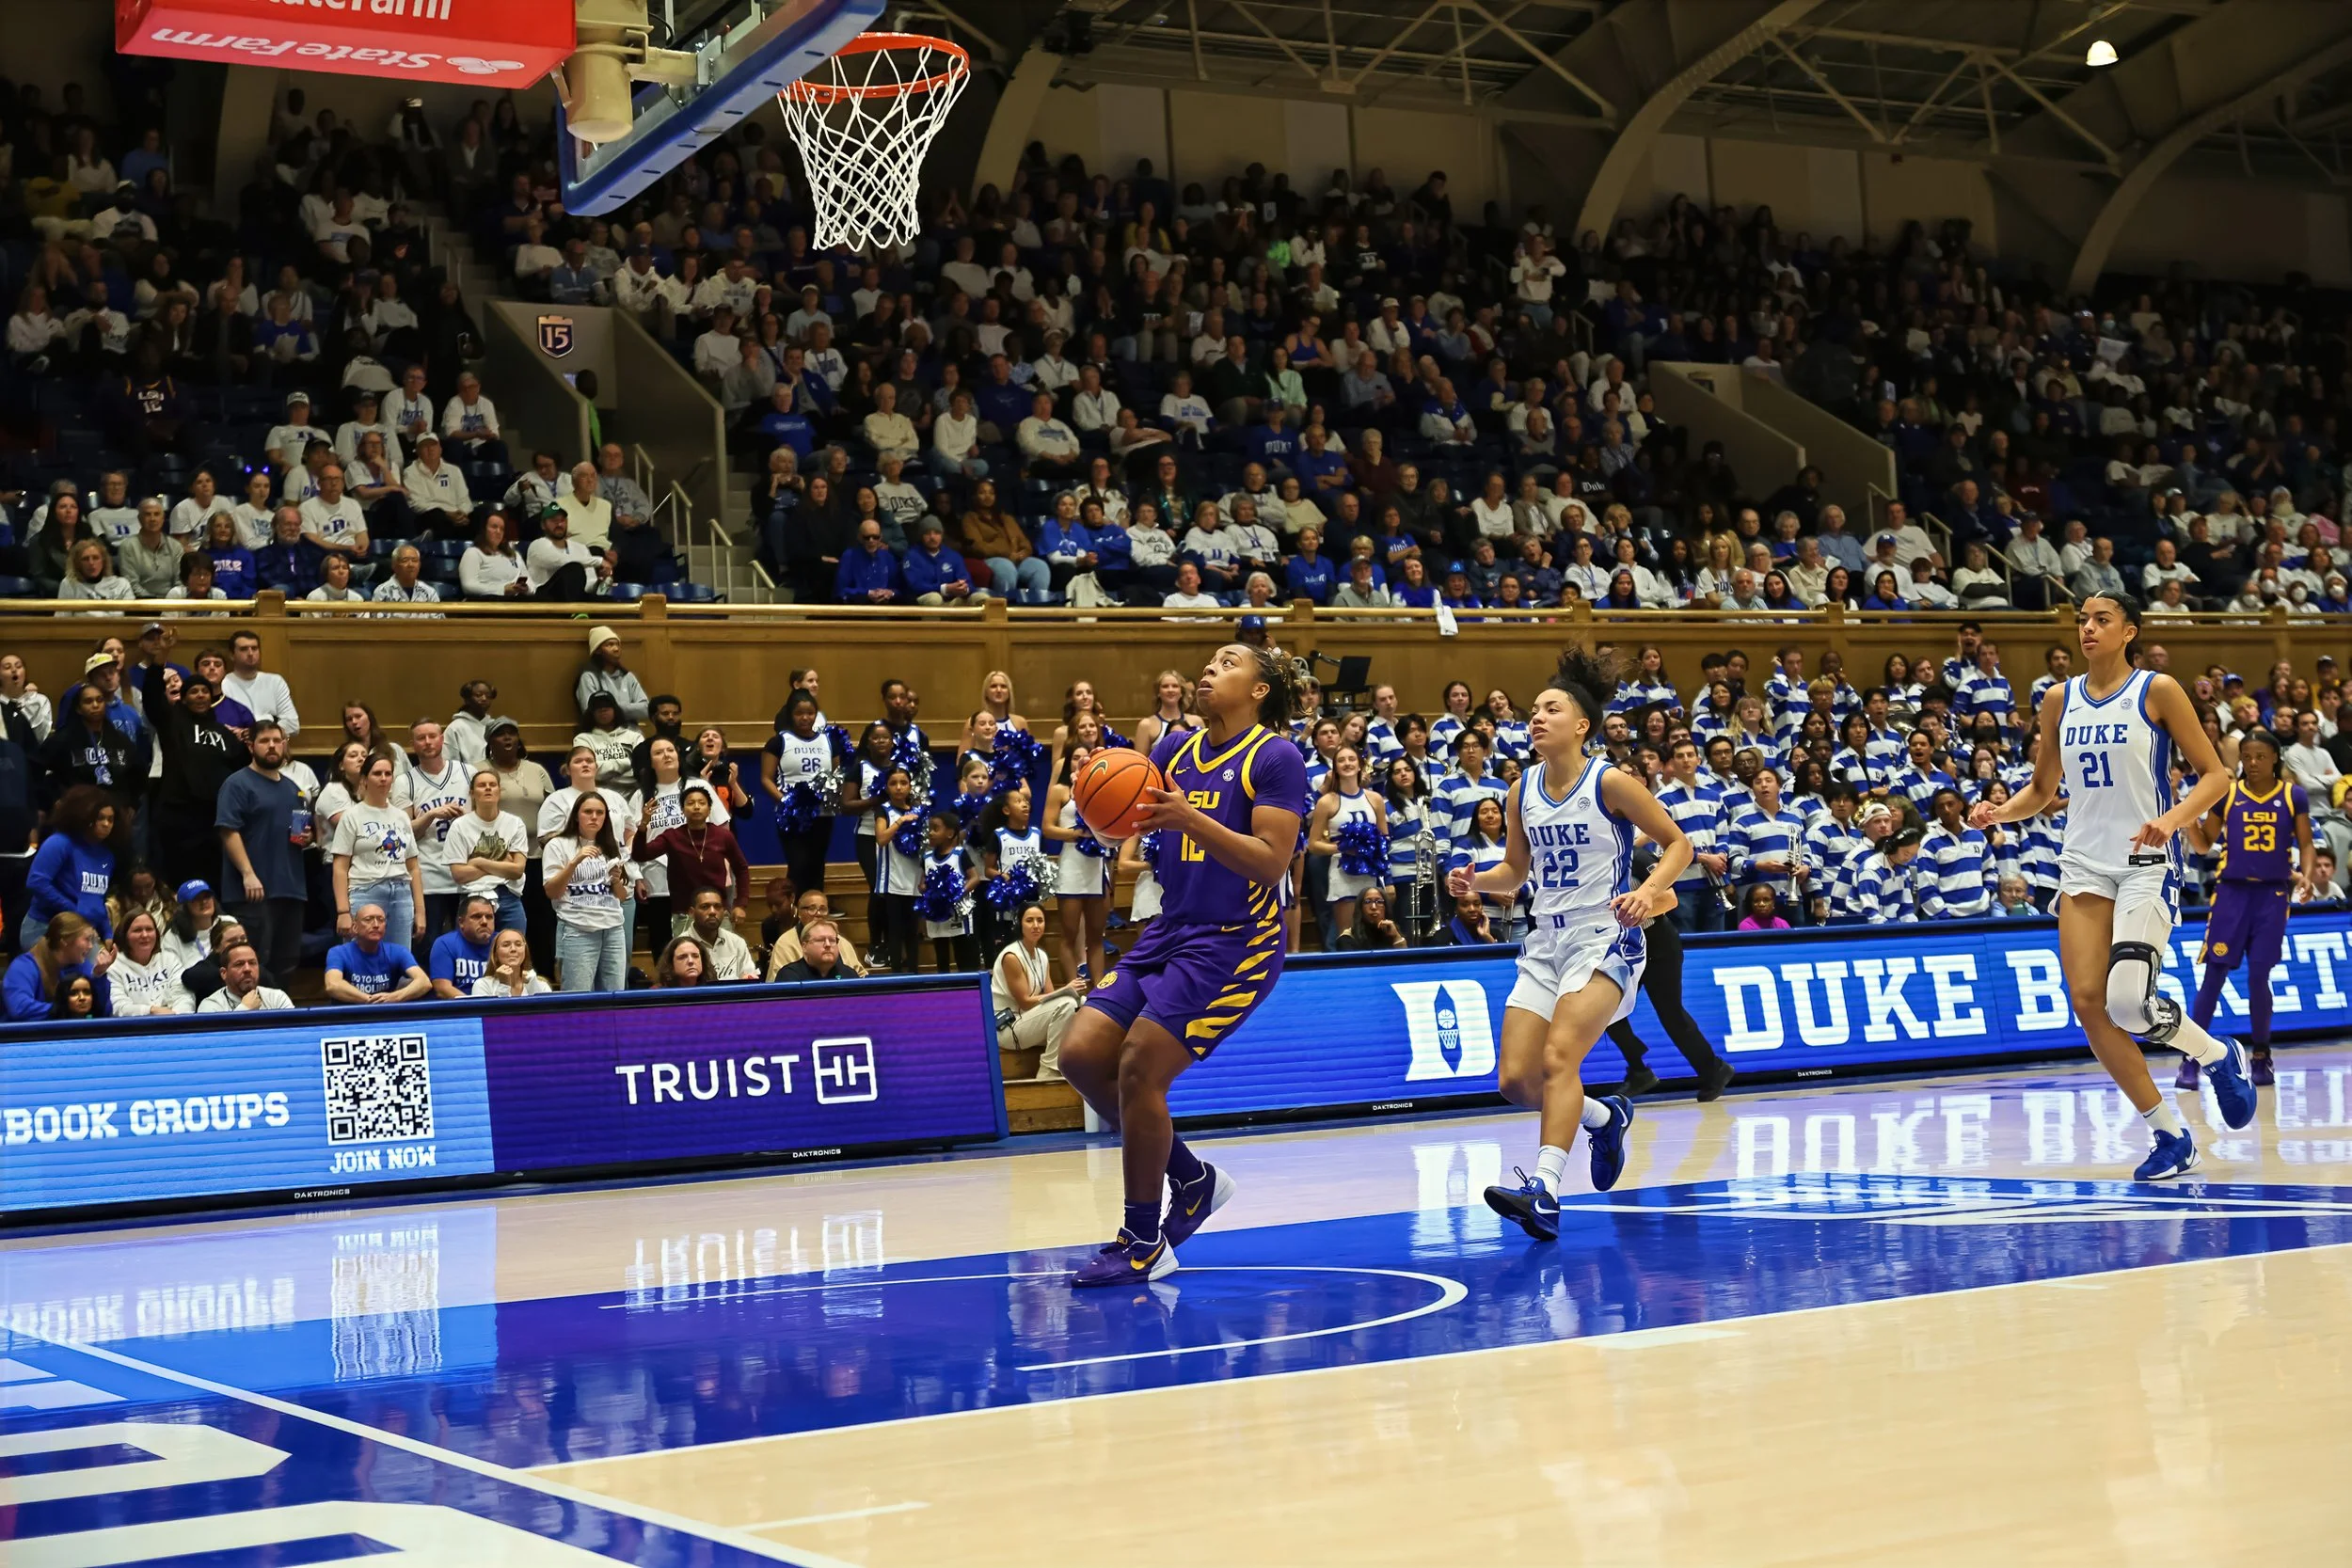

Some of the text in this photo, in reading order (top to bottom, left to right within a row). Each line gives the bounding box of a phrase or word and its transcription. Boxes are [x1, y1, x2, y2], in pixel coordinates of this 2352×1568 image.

[151, 27, 442, 69] StateFarm
[545, 326, 569, 349] 15
[2065, 724, 2128, 746] DUKE
[794, 747, 824, 755] DUKE
[802, 758, 821, 773] 26
[2078, 752, 2114, 787] 21
[421, 796, 467, 813] DUKE
[1183, 790, 1221, 810] SU
[650, 819, 669, 830] BLUE
[2243, 812, 2277, 822] LSU
[1529, 824, 1590, 847] DUKE
[2243, 824, 2277, 852] 23
[1009, 846, 1036, 856] DUKE
[1543, 848, 1580, 888] 22
[566, 882, 611, 896] DUK
[351, 974, 360, 983] GO
[361, 974, 372, 983] TO
[2005, 932, 2352, 1033] BSKET
[1713, 954, 1988, 1053] DUKE
[614, 1054, 800, 1105] TRUIST
[1373, 1102, 1413, 1111] DAKTRONICS
[0, 1091, 291, 1146] BOOK GROUPS
[329, 1145, 437, 1174] JOIN NOW
[792, 1148, 841, 1159] DAKTRONICS
[294, 1188, 350, 1199] DAKTRONICS
